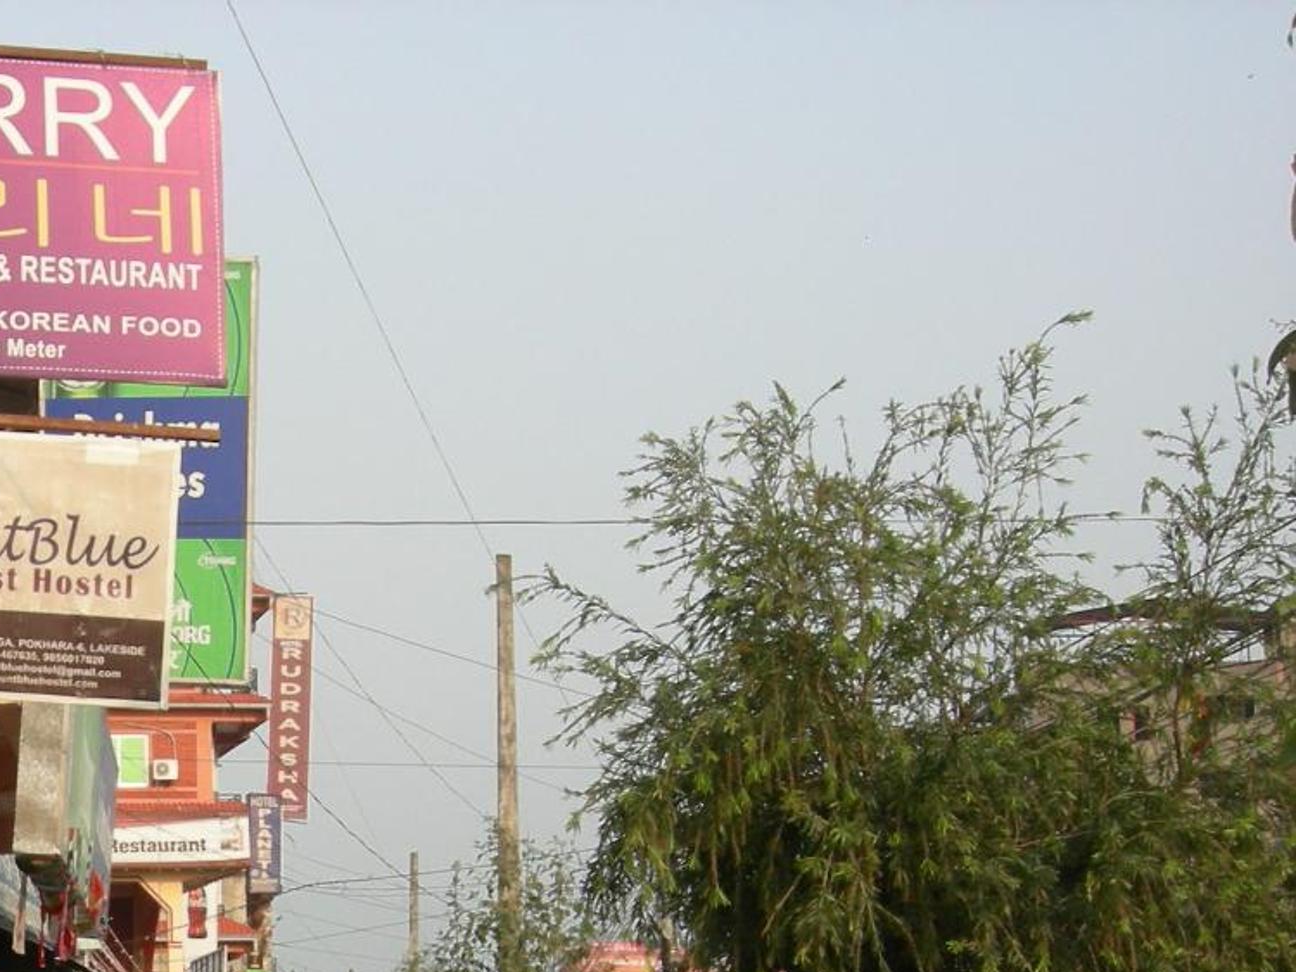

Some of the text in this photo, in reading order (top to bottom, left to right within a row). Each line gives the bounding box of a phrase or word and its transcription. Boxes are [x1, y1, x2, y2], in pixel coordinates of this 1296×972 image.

[20, 255, 203, 291] RESTAURANT
[121, 315, 202, 338] FOOD
[7, 337, 66, 358] Meter
[33, 567, 134, 599] Hostel
[90, 642, 146, 657] LAKESIDE
[278, 643, 303, 801] RUDRAKSHA
